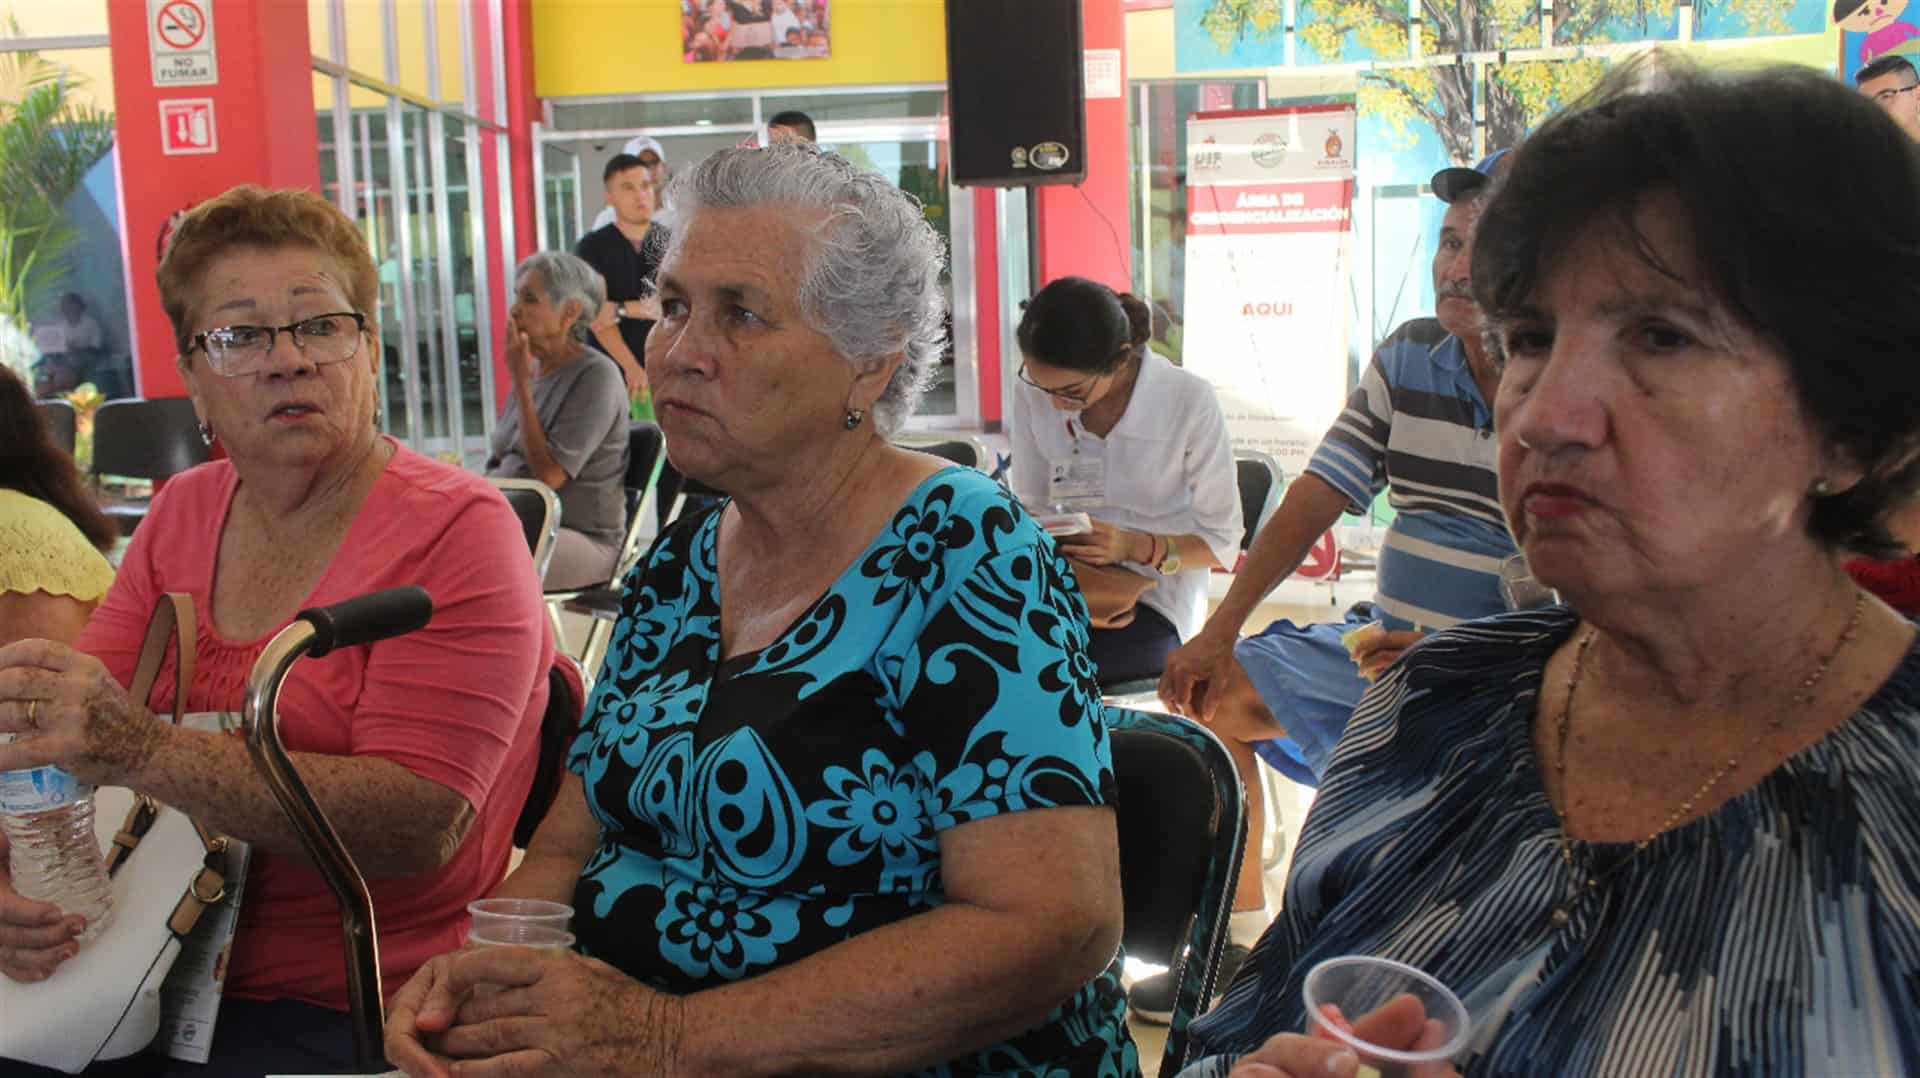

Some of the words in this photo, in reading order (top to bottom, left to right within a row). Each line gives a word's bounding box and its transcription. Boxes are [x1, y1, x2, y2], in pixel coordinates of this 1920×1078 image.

[174, 57, 193, 67] NO
[160, 67, 209, 79] FUMAR
[1281, 191, 1304, 207] DE
